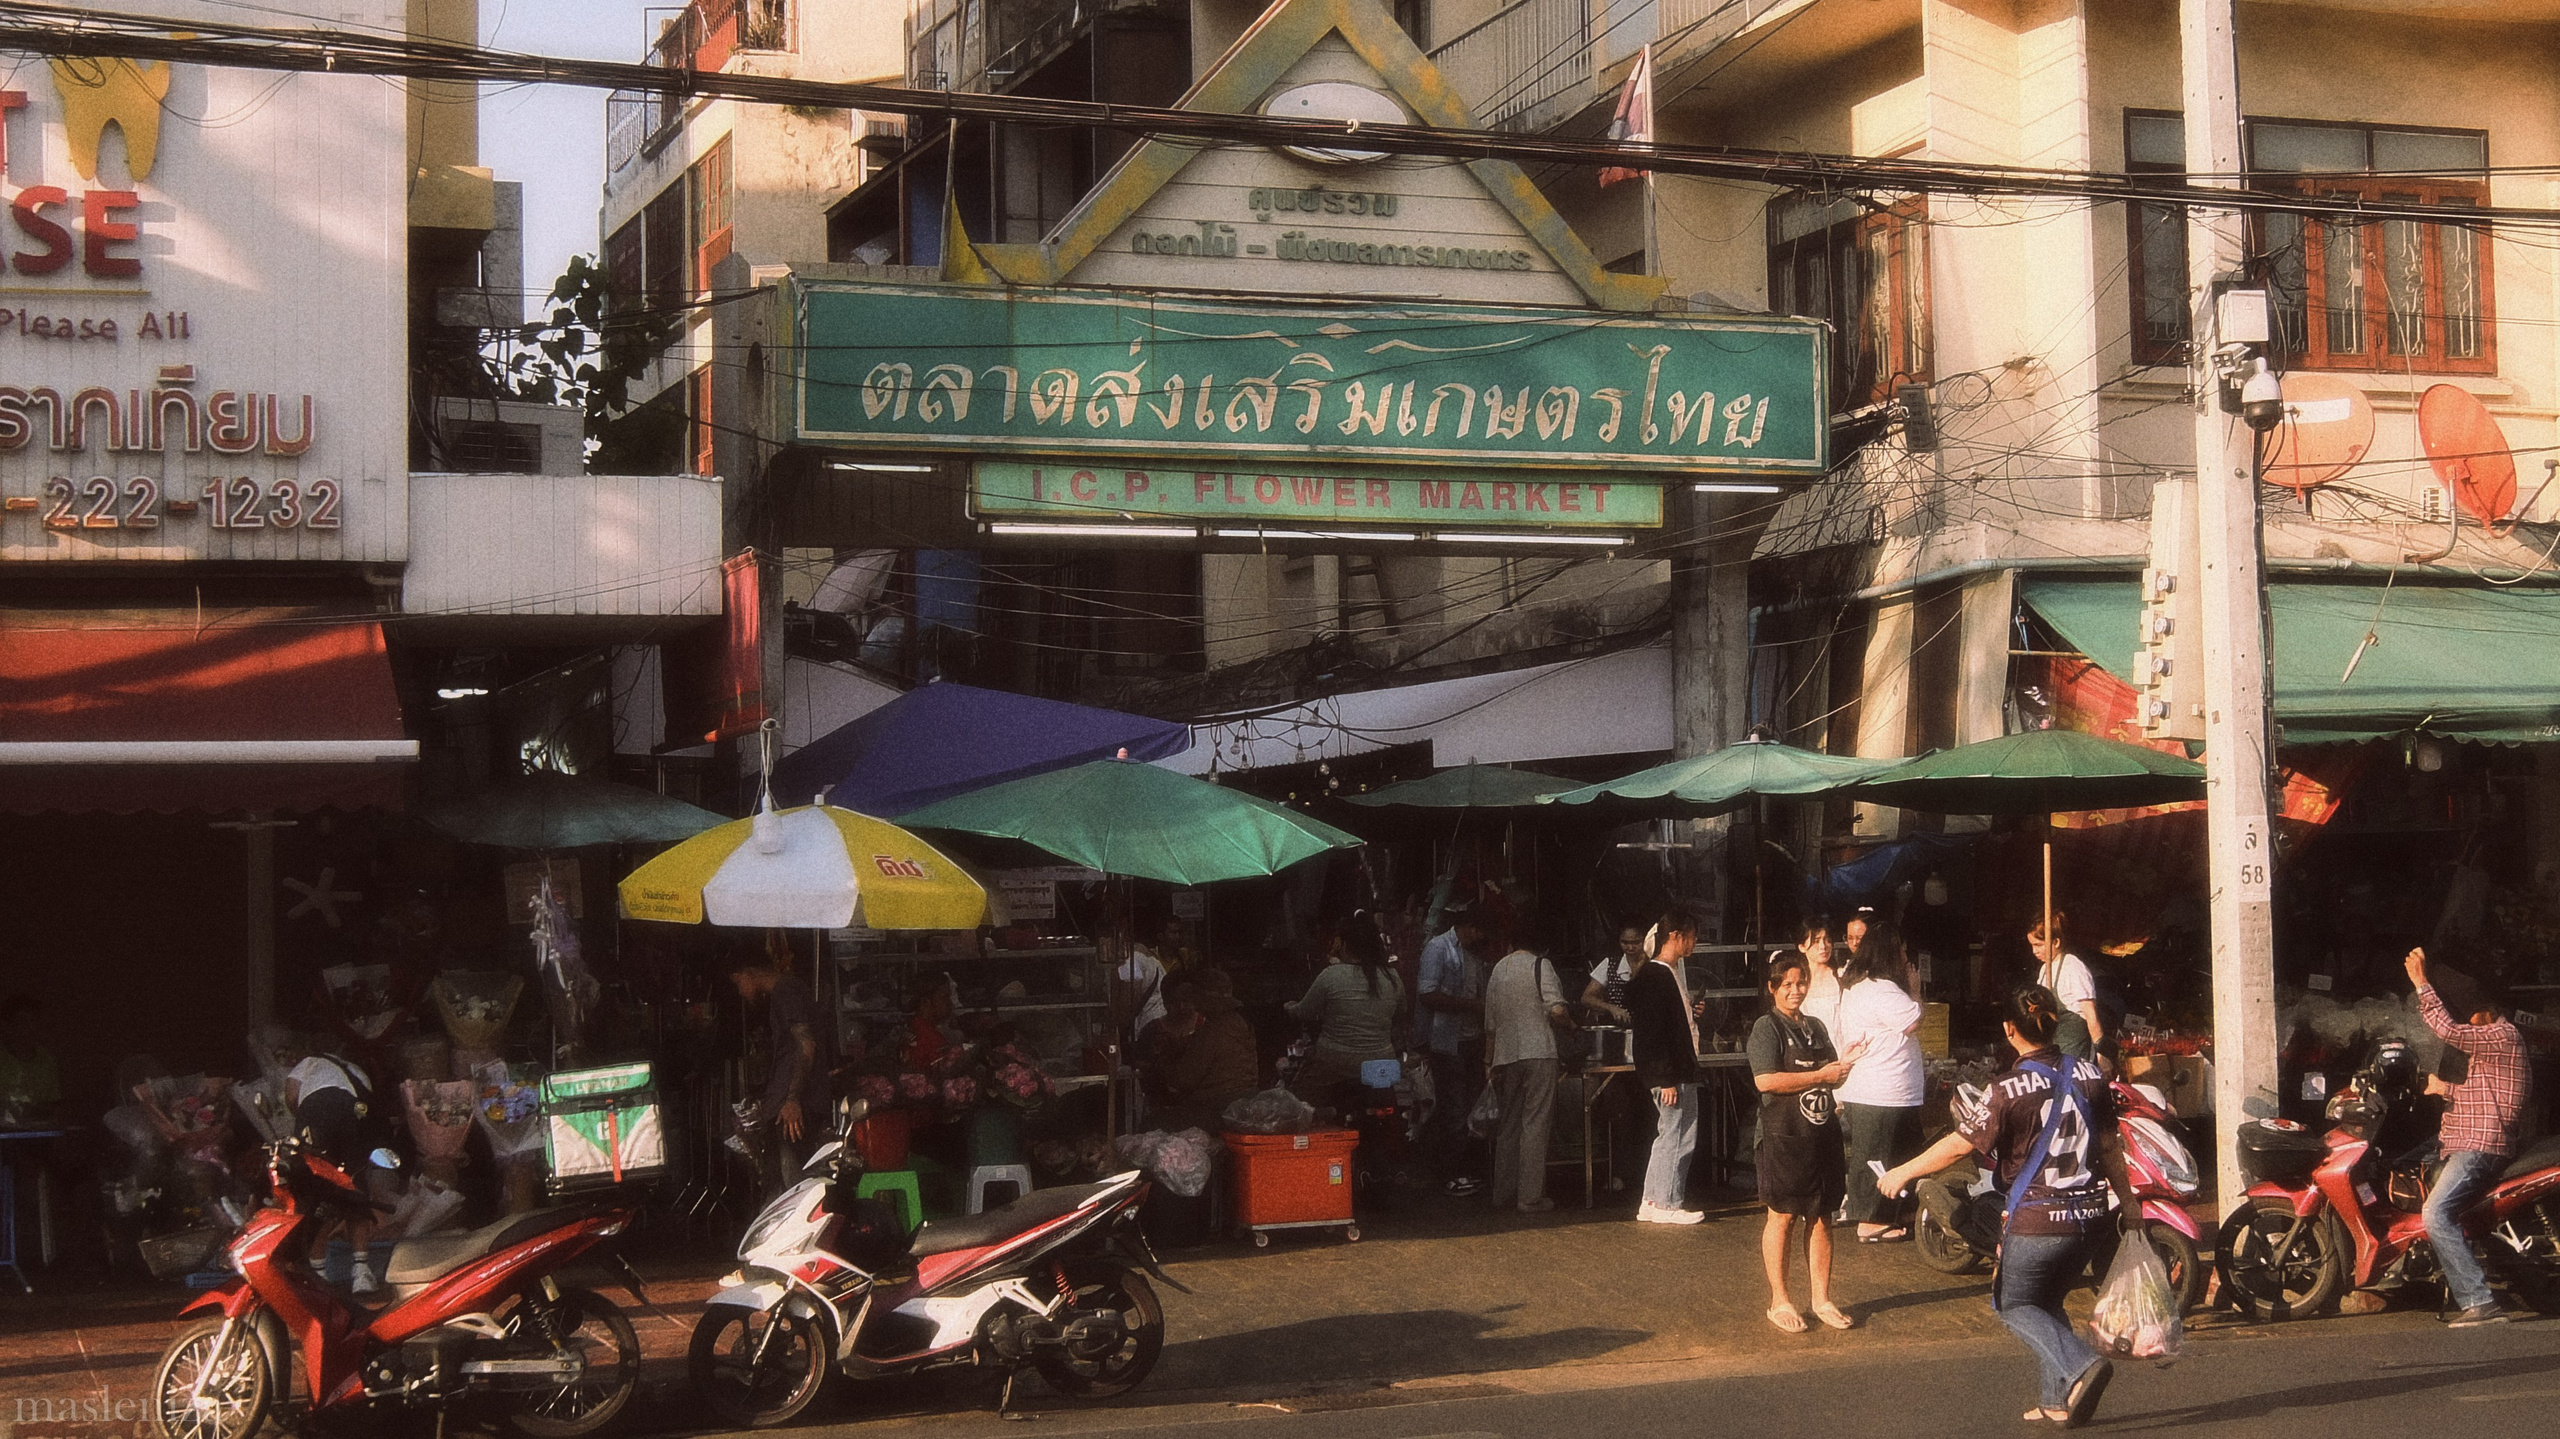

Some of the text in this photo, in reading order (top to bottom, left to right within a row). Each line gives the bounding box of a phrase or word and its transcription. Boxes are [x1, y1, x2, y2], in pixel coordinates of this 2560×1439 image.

[1248, 184, 1398, 221] ศูนย์รวม
[0, 185, 141, 276] SE
[1132, 221, 1237, 257] ดอกไม้
[1276, 230, 1531, 271] พืชผลการเกษตร
[138, 311, 190, 340] All
[861, 336, 1769, 448] ตลาดส่งเสริมเกษตรไทย
[1032, 469, 1613, 514] I.C.P. FLOWER MARKET
[2241, 864, 2264, 885] 58
[1999, 1062, 2102, 1099] THAIAND
[1805, 1094, 1829, 1111] 70
